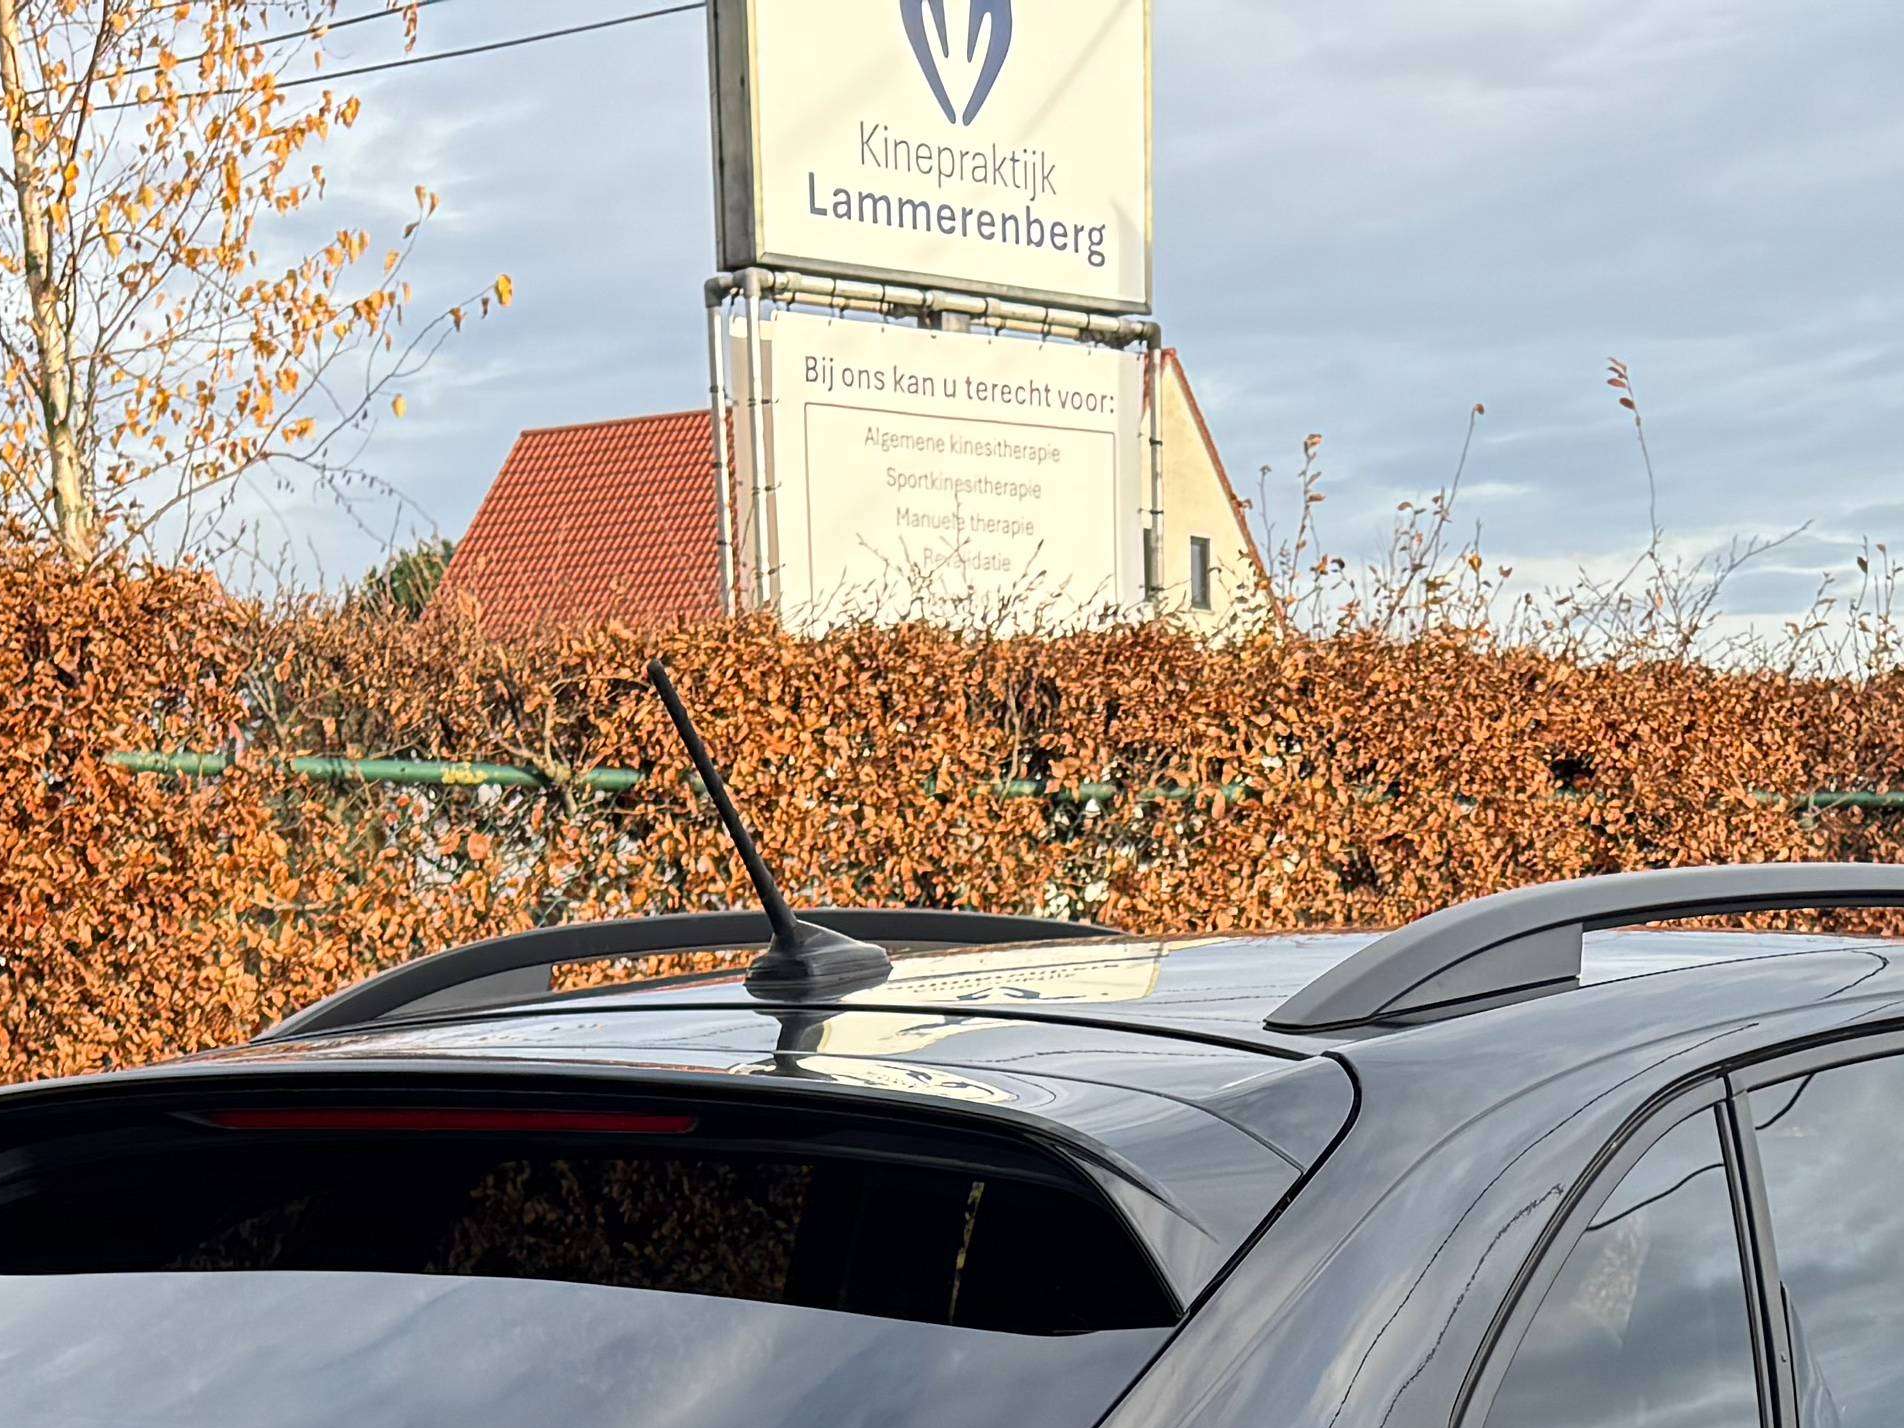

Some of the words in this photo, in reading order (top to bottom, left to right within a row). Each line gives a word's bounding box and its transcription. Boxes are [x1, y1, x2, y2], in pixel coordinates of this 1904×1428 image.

[859, 120, 1057, 202] Kinepraktijk
[807, 171, 1106, 268] Lammerenberg
[804, 355, 834, 392] Bij
[841, 365, 886, 392] ons
[893, 365, 935, 397] kan
[943, 377, 957, 399] u
[964, 376, 1052, 408] terecht
[1057, 387, 1115, 414] voor:
[864, 426, 946, 453] Algemene
[949, 433, 1062, 466] kinesitherapie
[885, 466, 1043, 500] Sportkinesitherapie
[896, 506, 966, 532] Manuele
[969, 512, 1035, 538] therapie
